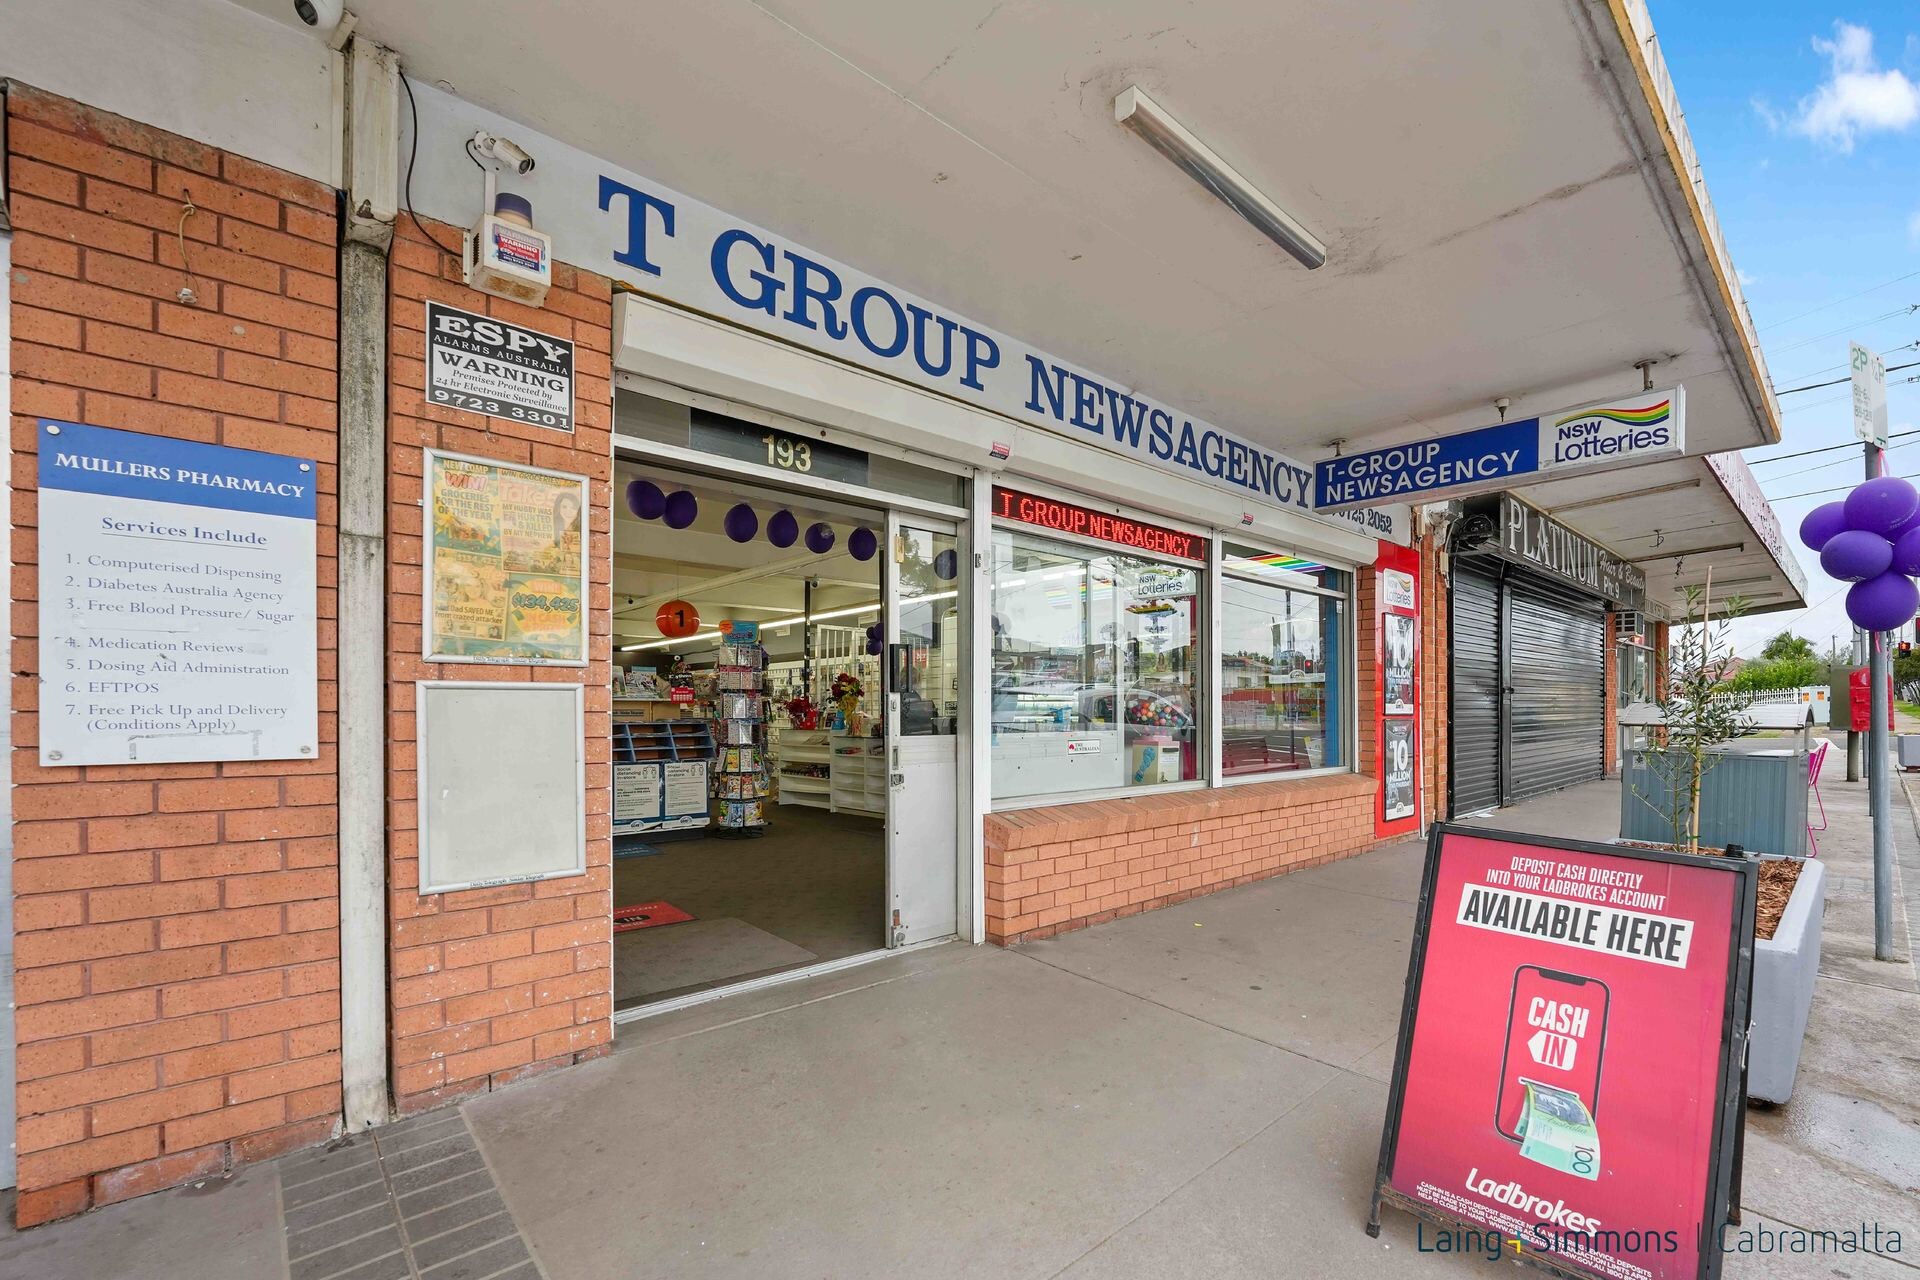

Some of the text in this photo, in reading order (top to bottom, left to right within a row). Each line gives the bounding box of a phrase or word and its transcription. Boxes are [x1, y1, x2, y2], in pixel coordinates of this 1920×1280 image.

[500, 236, 538, 254] WARNING
[434, 334, 568, 376] ALARMS AUSTRALIA
[435, 314, 569, 363] ESPY
[599, 174, 1313, 509] T GROUP NEWSAGENCY
[438, 350, 565, 393] WARNING
[452, 369, 552, 401] Premises Protected by
[434, 389, 569, 429] 9723 3301
[436, 376, 567, 413] 24 hr Electronic Surveillance
[1554, 426, 1670, 464] Lotteries
[1558, 420, 1602, 442] NSW
[762, 434, 812, 472] 193
[1325, 442, 1440, 483] T-GROUP
[54, 452, 305, 498] MULLERS PHARMACY
[444, 470, 488, 492] WIN!
[1325, 449, 1520, 504] NEWSAGENCY
[436, 496, 495, 513] FOR THE REST
[440, 488, 490, 503] GROCERIES
[438, 505, 450, 515] OF
[452, 508, 469, 518] THE
[470, 510, 492, 521] YEAR
[1000, 492, 1190, 556] T GROUP NEWSAGENCY
[1368, 508, 1392, 534] 2052
[102, 517, 268, 546] Services Include
[1508, 498, 1600, 590] PLATINUM
[66, 553, 282, 584] 1. Computerised Dispensing
[1140, 574, 1156, 584] NSW
[1599, 550, 1616, 577] Hair
[1626, 564, 1645, 597] Beauty
[64, 576, 284, 605] 2. Diabetes Australia Agency
[1138, 580, 1182, 596] Lotteries
[1386, 590, 1412, 606] Lotteries
[65, 598, 294, 625] 3. Free Blood Pressure/ Sugar
[675, 610, 685, 628] 1
[88, 637, 177, 652] Medication
[182, 640, 244, 654] Reviews
[66, 659, 290, 676] 5. Dosing Aid Administration
[65, 682, 160, 694] 6. EFTPOS
[66, 704, 288, 718] 7. Free Pick Up and Delivery
[87, 720, 236, 734] (Conditions Apply)
[1510, 856, 1644, 889] DEPOSIT CASH DIRECTLY
[1486, 869, 1666, 911] INTO YOUR LADBROKES ACCOUNT
[1462, 889, 1686, 963] AVAILABLE HERE
[1527, 996, 1590, 1038] CASH
[1540, 1034, 1568, 1068] IN
[1572, 1144, 1596, 1174] 100
[1465, 1167, 1602, 1238] Ladbrokes
[1416, 1185, 1432, 1196] MUST
[1440, 1194, 1458, 1206] MADE
[1468, 1206, 1485, 1216] YOUR
[1486, 1212, 1522, 1232] LADBROKES
[1606, 1261, 1630, 1276] LIMITS
[1418, 1190, 1432, 1200] HELP
[1439, 1200, 1458, 1212] CLOSE
[1468, 1212, 1486, 1224] HAND.
[1606, 1268, 1624, 1279] 1800
[1420, 1181, 1444, 1194] CASH-IN
[1456, 1196, 1472, 1206] CASH
[1473, 1202, 1498, 1216] DEPOSIT
[1500, 1212, 1526, 1226] SERVICE
[1584, 1246, 1616, 1264] ERVICE.
[1616, 1260, 1652, 1278] DEPOSITS
